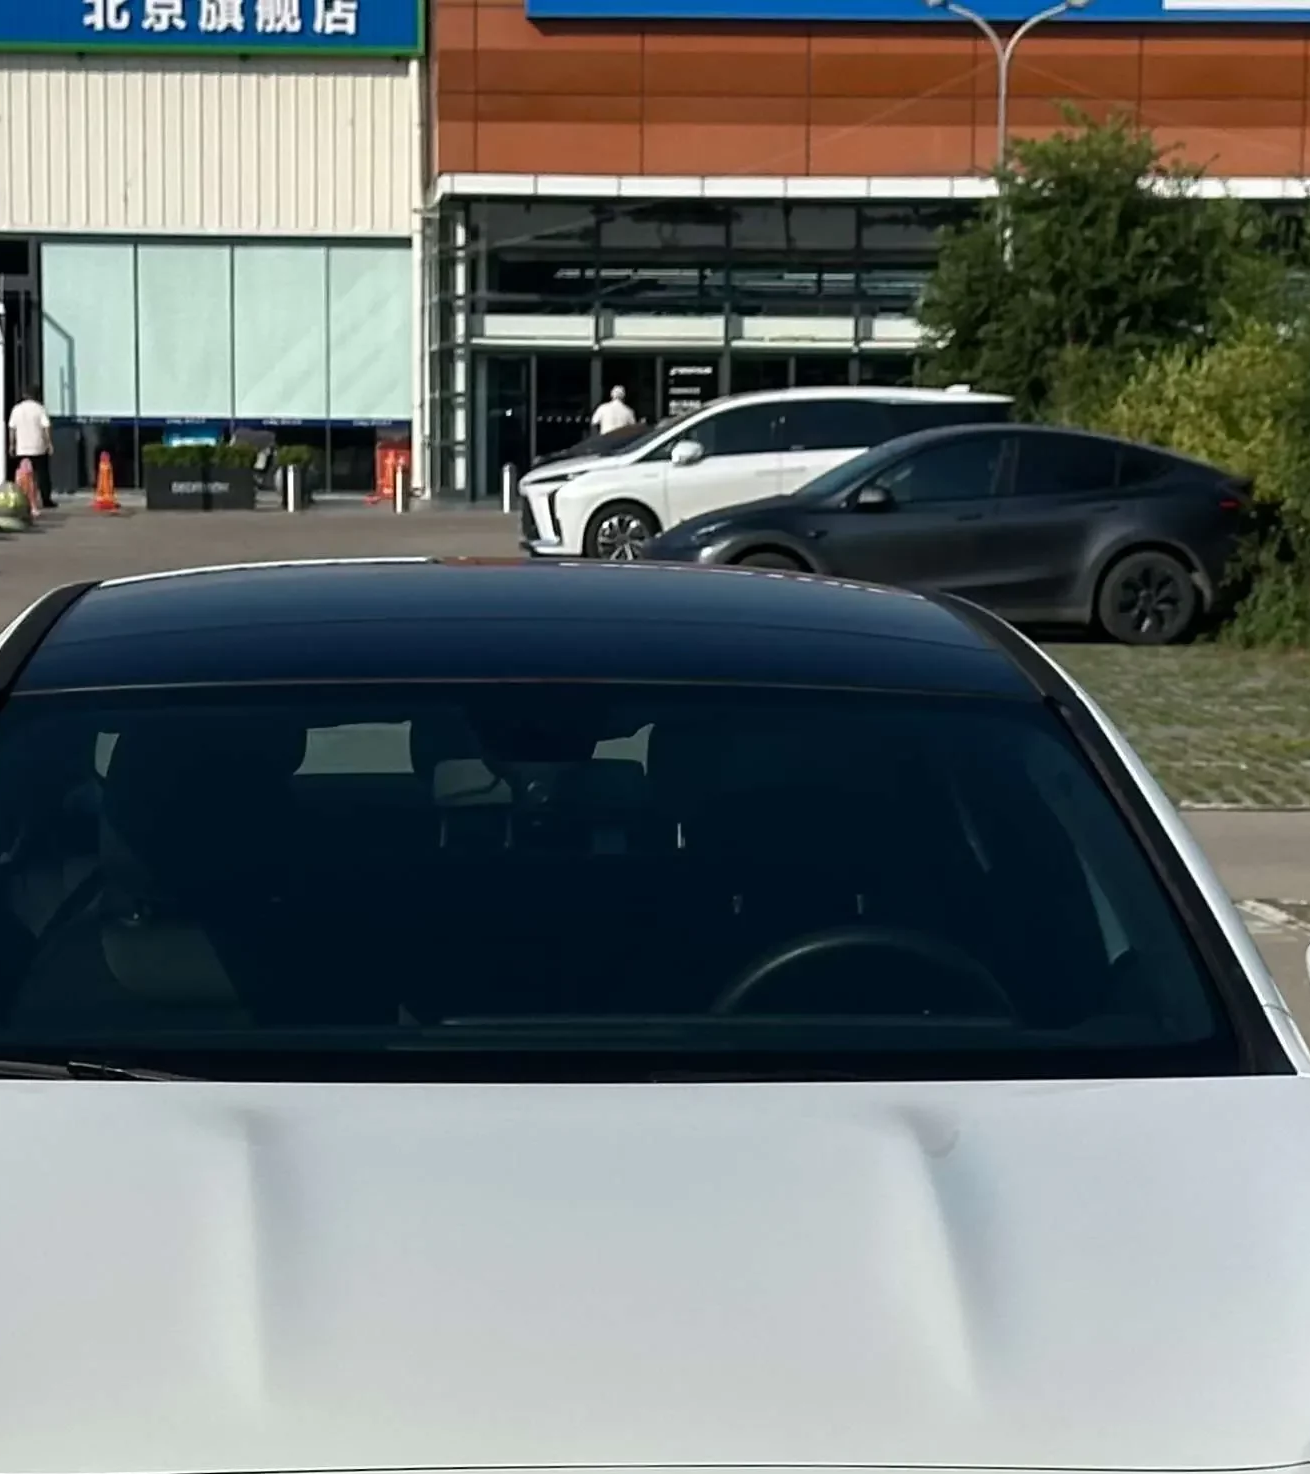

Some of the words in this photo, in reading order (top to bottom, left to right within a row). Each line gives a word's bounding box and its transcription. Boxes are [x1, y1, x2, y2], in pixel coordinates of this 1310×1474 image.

[82, 0, 359, 35] 北京旗舰店
